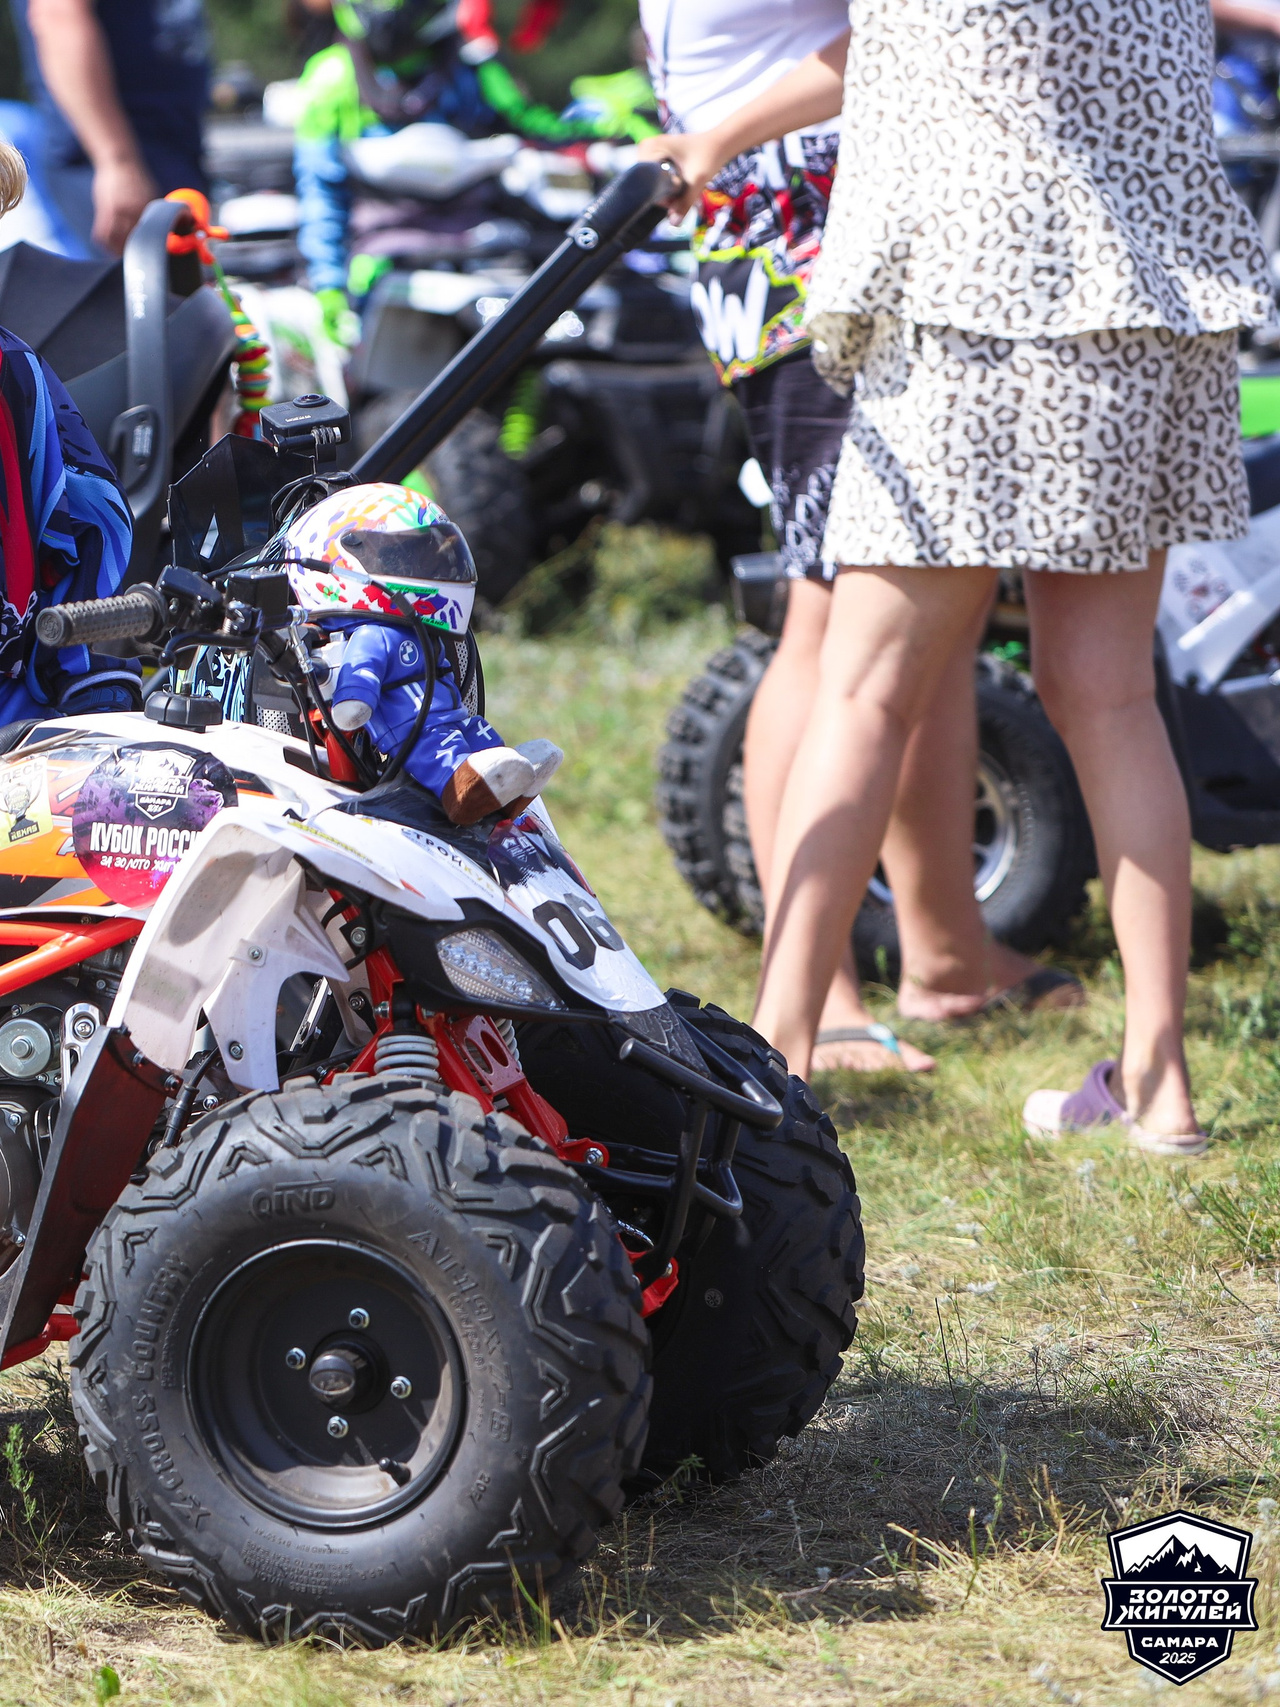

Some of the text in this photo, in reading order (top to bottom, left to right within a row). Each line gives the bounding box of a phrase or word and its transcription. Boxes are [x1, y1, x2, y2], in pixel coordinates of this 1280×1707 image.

[89, 821, 144, 856] КУБОК
[532, 893, 625, 971] 06
[131, 1251, 190, 1383] COUNTRY
